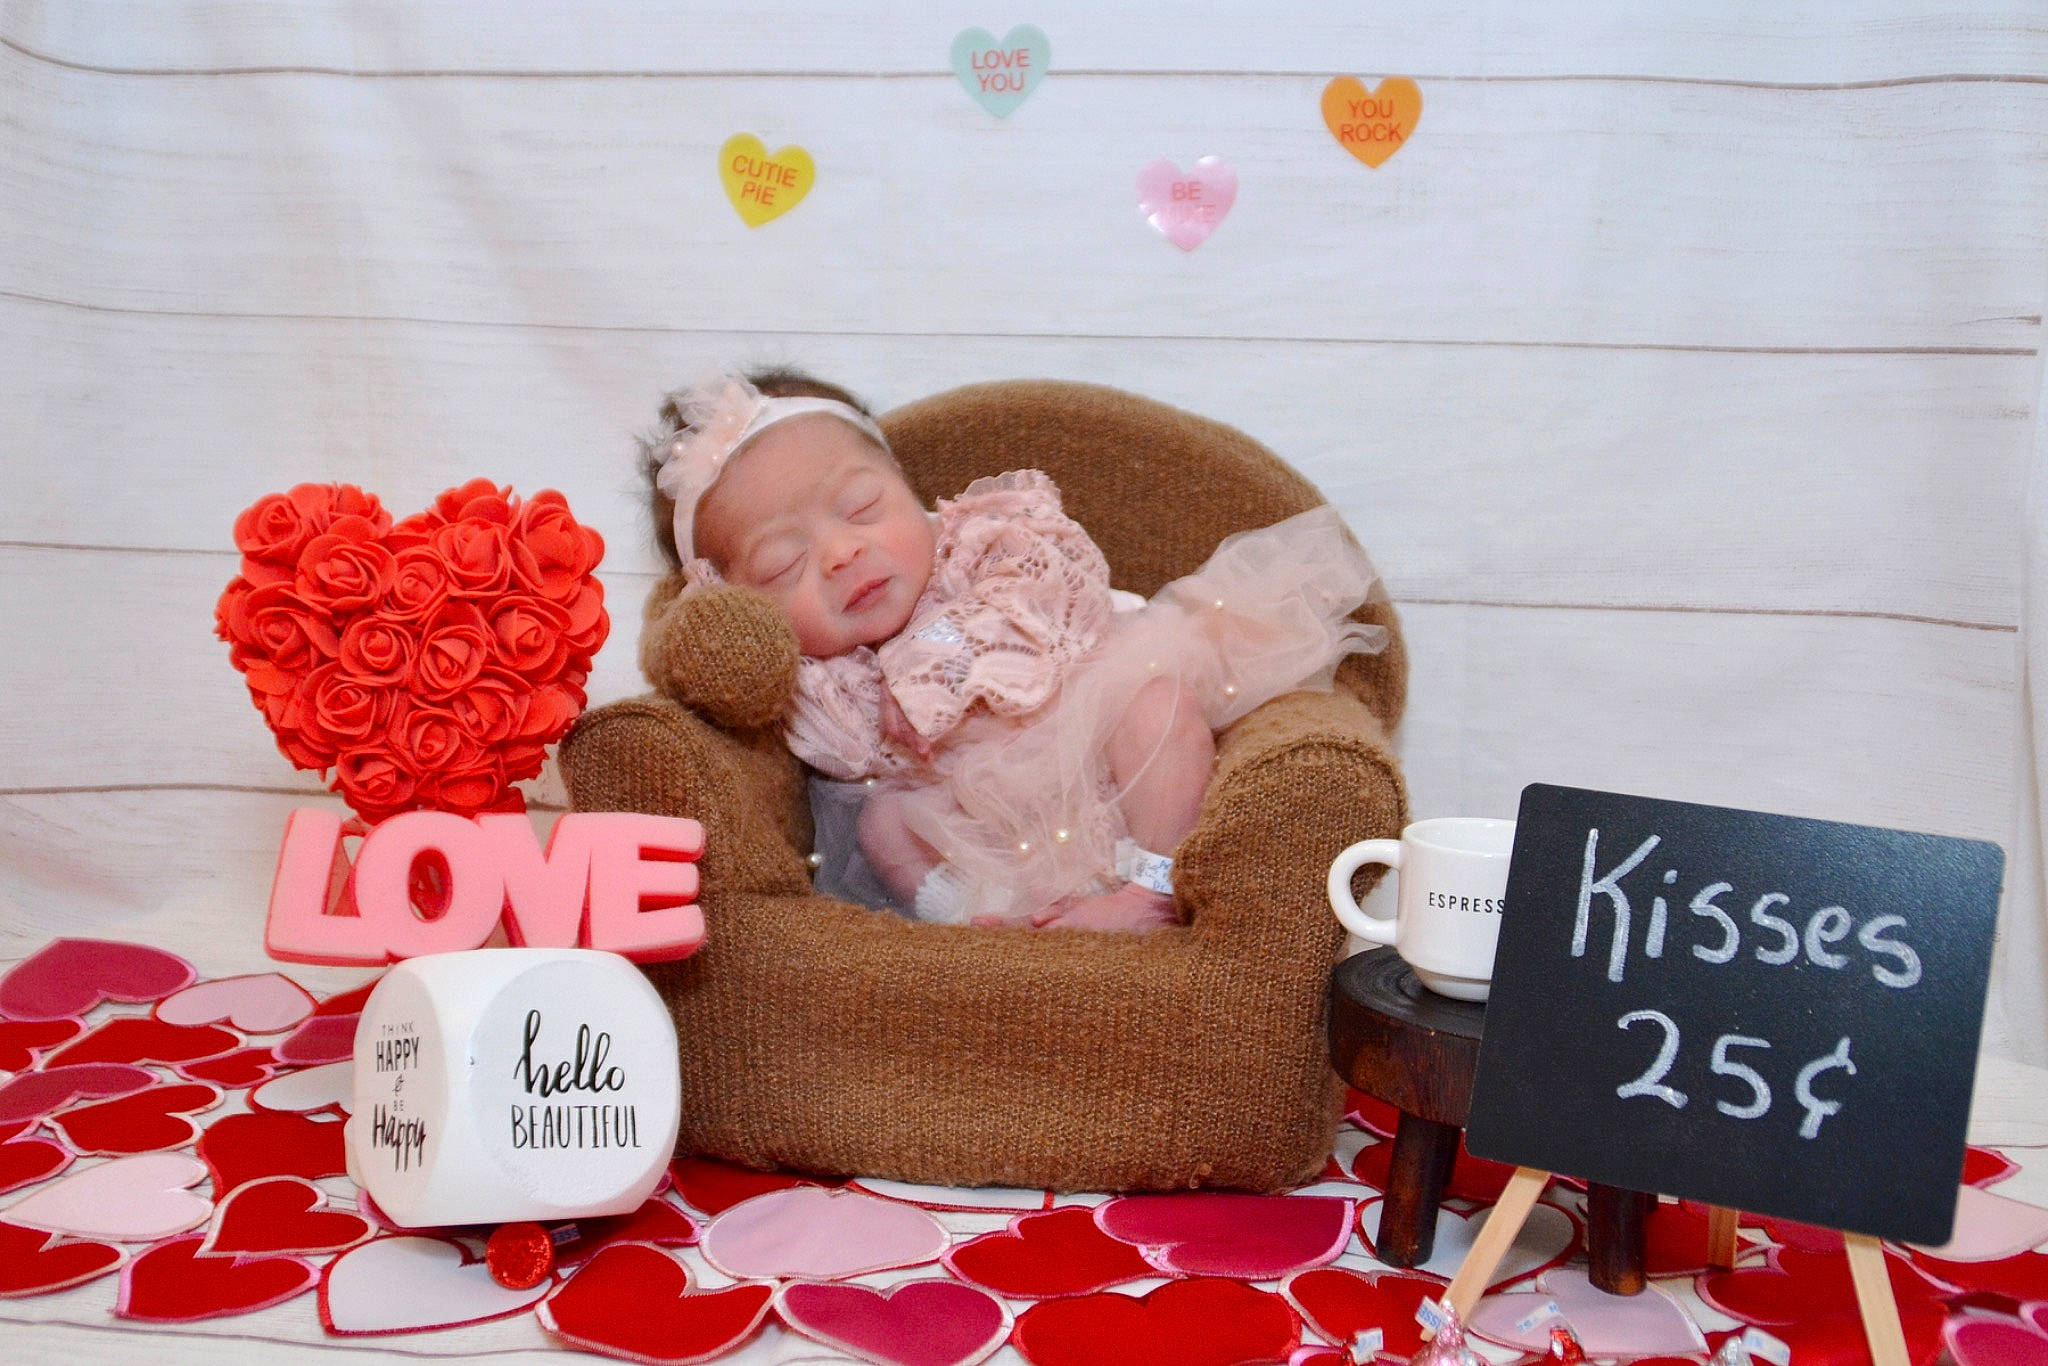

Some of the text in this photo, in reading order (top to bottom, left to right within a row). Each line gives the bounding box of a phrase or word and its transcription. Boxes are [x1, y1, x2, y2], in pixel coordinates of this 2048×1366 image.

[971, 48, 1030, 71] LOVE
[976, 73, 1026, 93] YOU
[1347, 98, 1394, 119] YOU
[1339, 123, 1403, 143] ROCK
[731, 154, 798, 188] CUTIE
[740, 180, 777, 206] PIE
[1171, 181, 1202, 201] BE
[264, 807, 707, 967] LOVE
[1429, 892, 1505, 915] ESPRESS
[1570, 827, 1923, 989] Kisses
[381, 1022, 415, 1036] THINK
[376, 1036, 420, 1073] HAPPY
[512, 1008, 626, 1099] hello
[1616, 1009, 1858, 1139] 25¢
[393, 1099, 405, 1112] BE
[372, 1103, 427, 1173] Happy
[511, 1104, 643, 1150] BEAUTIFUL
